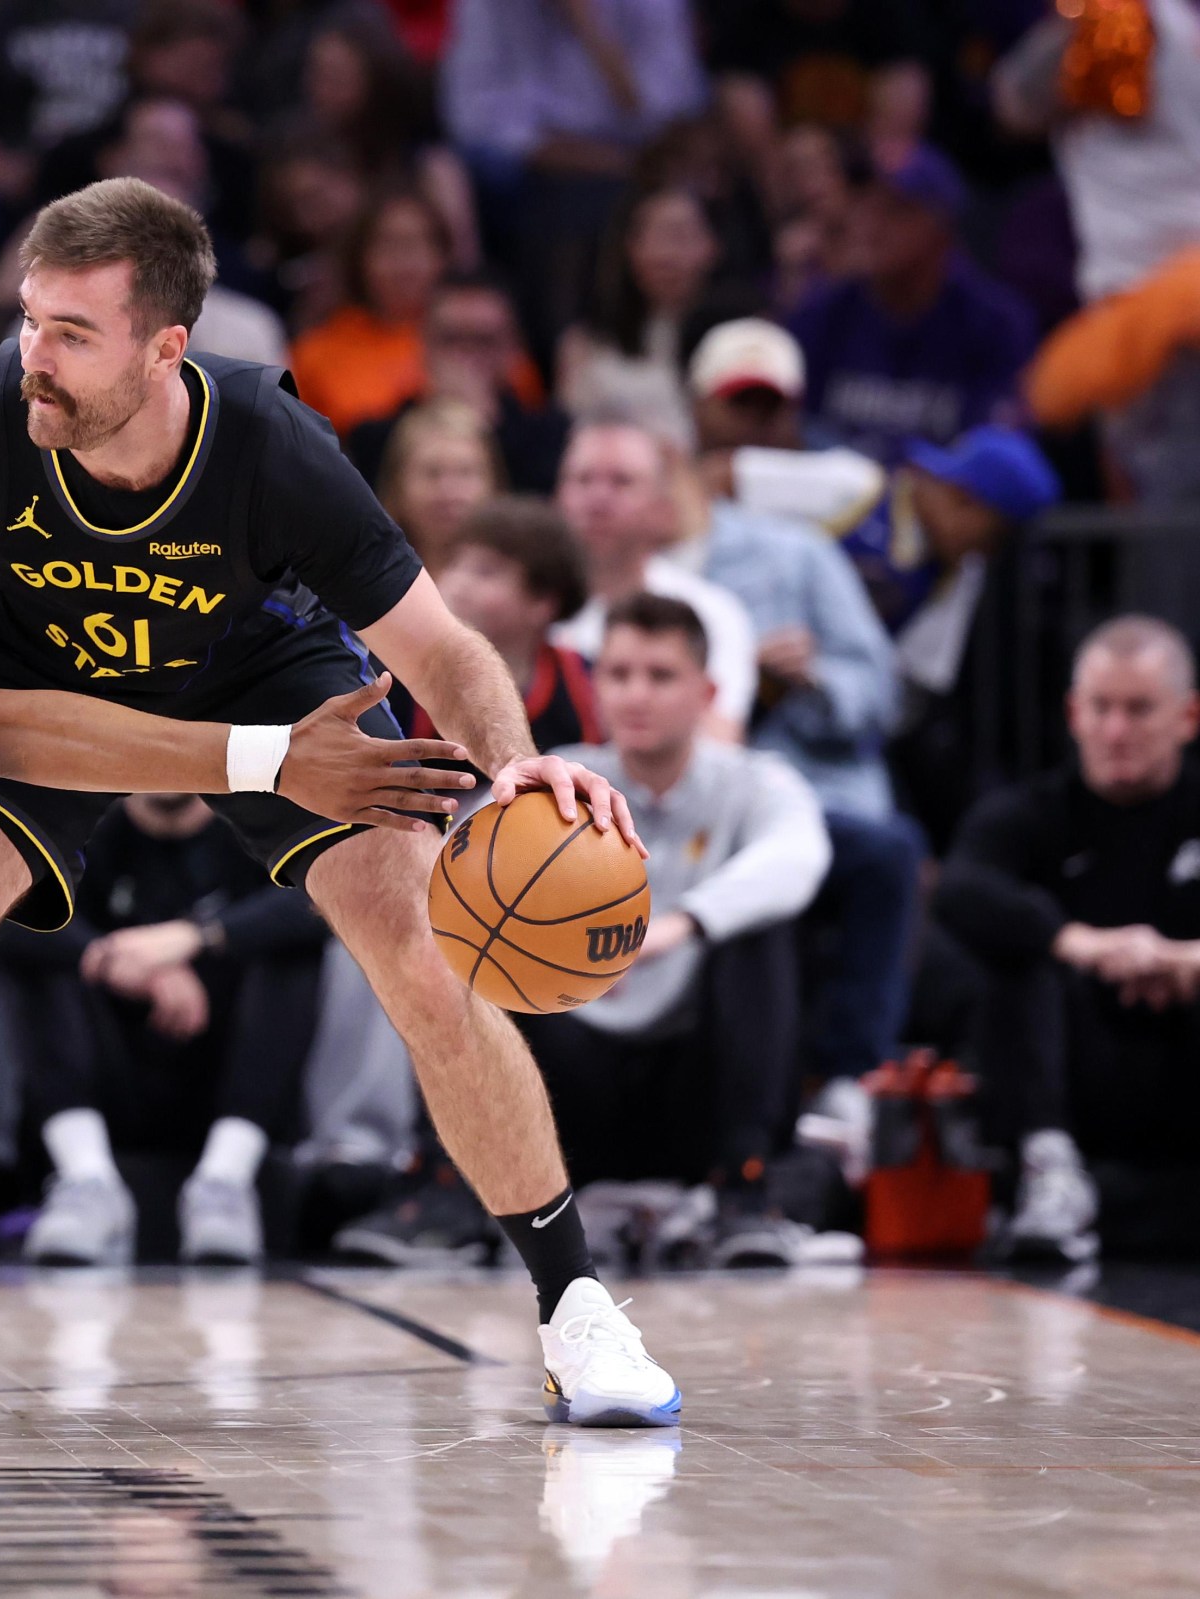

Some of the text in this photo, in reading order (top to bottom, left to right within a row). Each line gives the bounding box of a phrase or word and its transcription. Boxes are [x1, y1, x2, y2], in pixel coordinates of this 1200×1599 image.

[150, 541, 222, 559] Rakuten
[10, 560, 226, 615] GOLDEN
[45, 623, 197, 678] STA
[83, 612, 150, 666] 61
